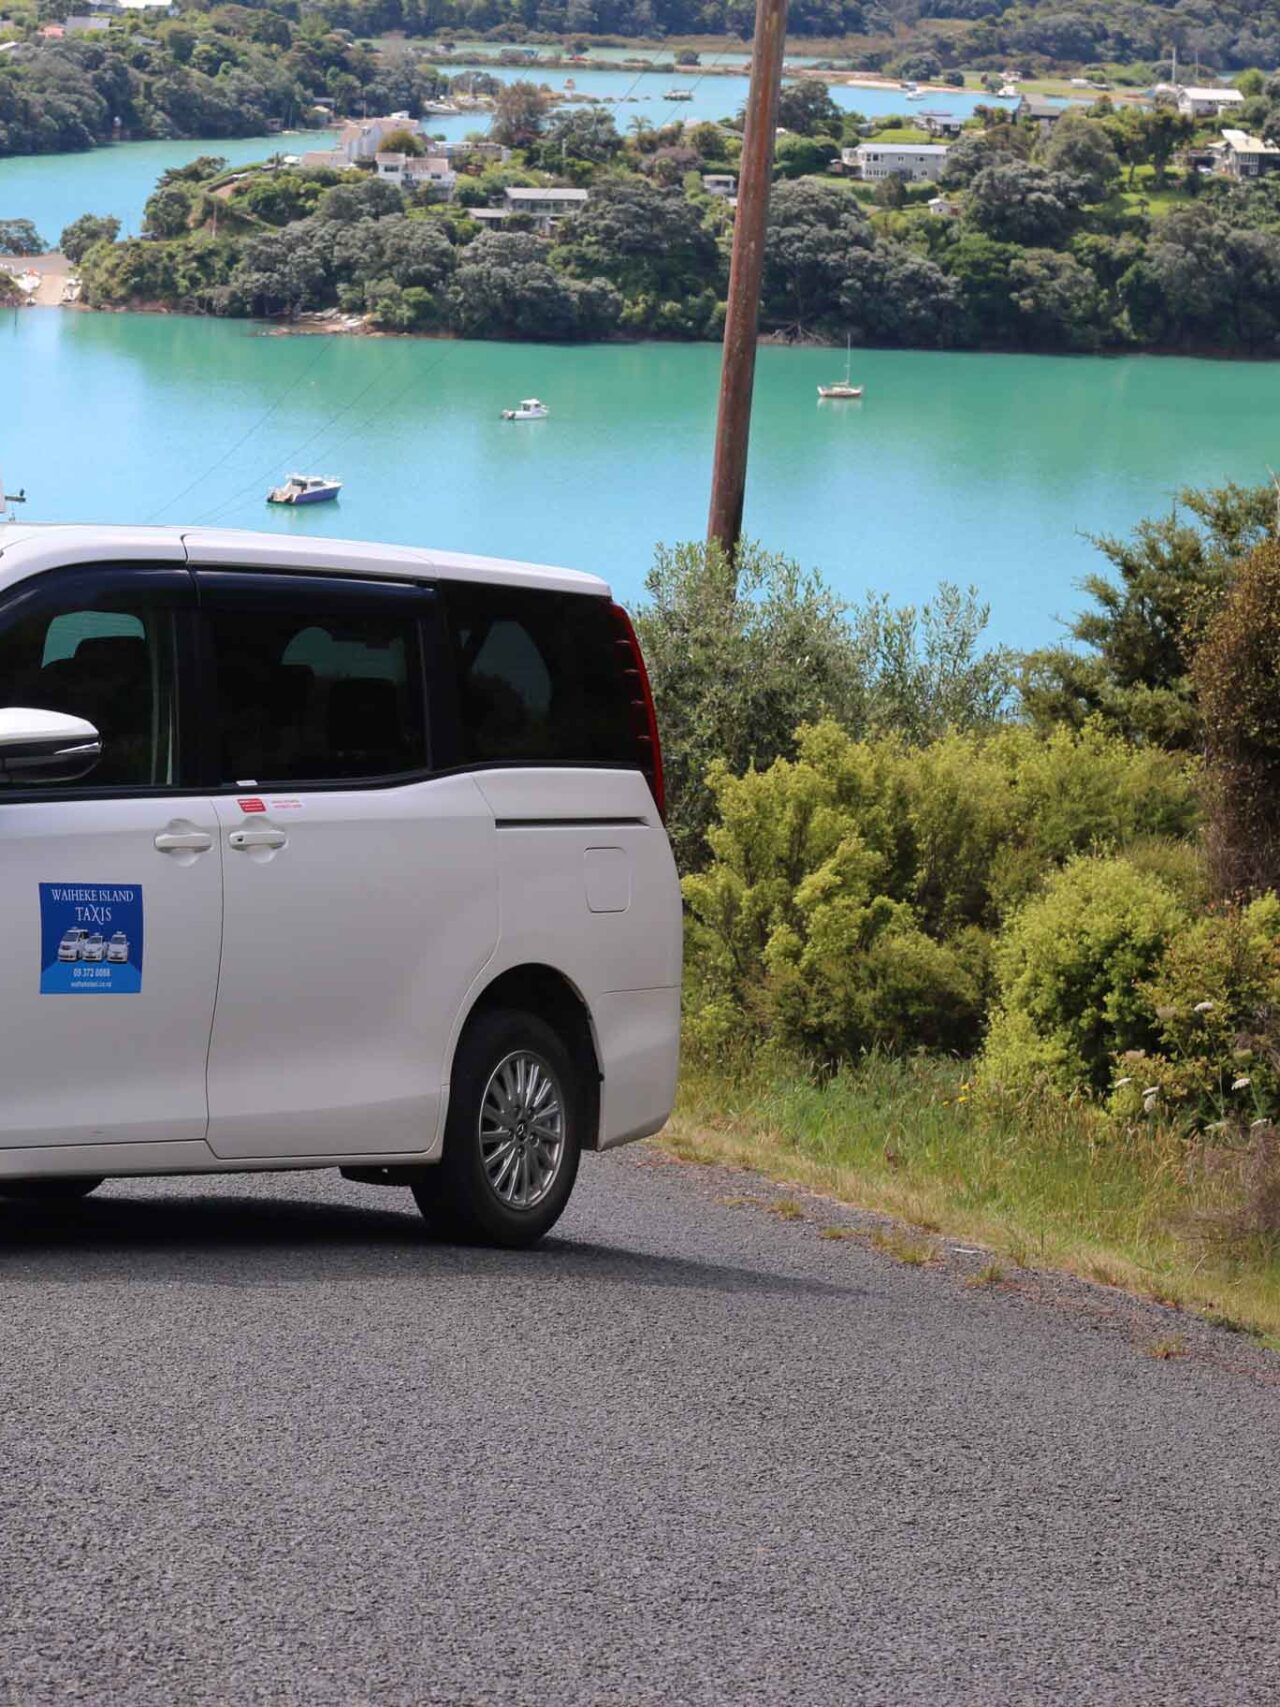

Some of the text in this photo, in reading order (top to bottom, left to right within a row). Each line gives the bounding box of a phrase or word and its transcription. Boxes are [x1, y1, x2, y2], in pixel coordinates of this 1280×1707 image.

[51, 889, 134, 902] WAIHEKE ISLAND
[75, 904, 112, 925] TAXIS
